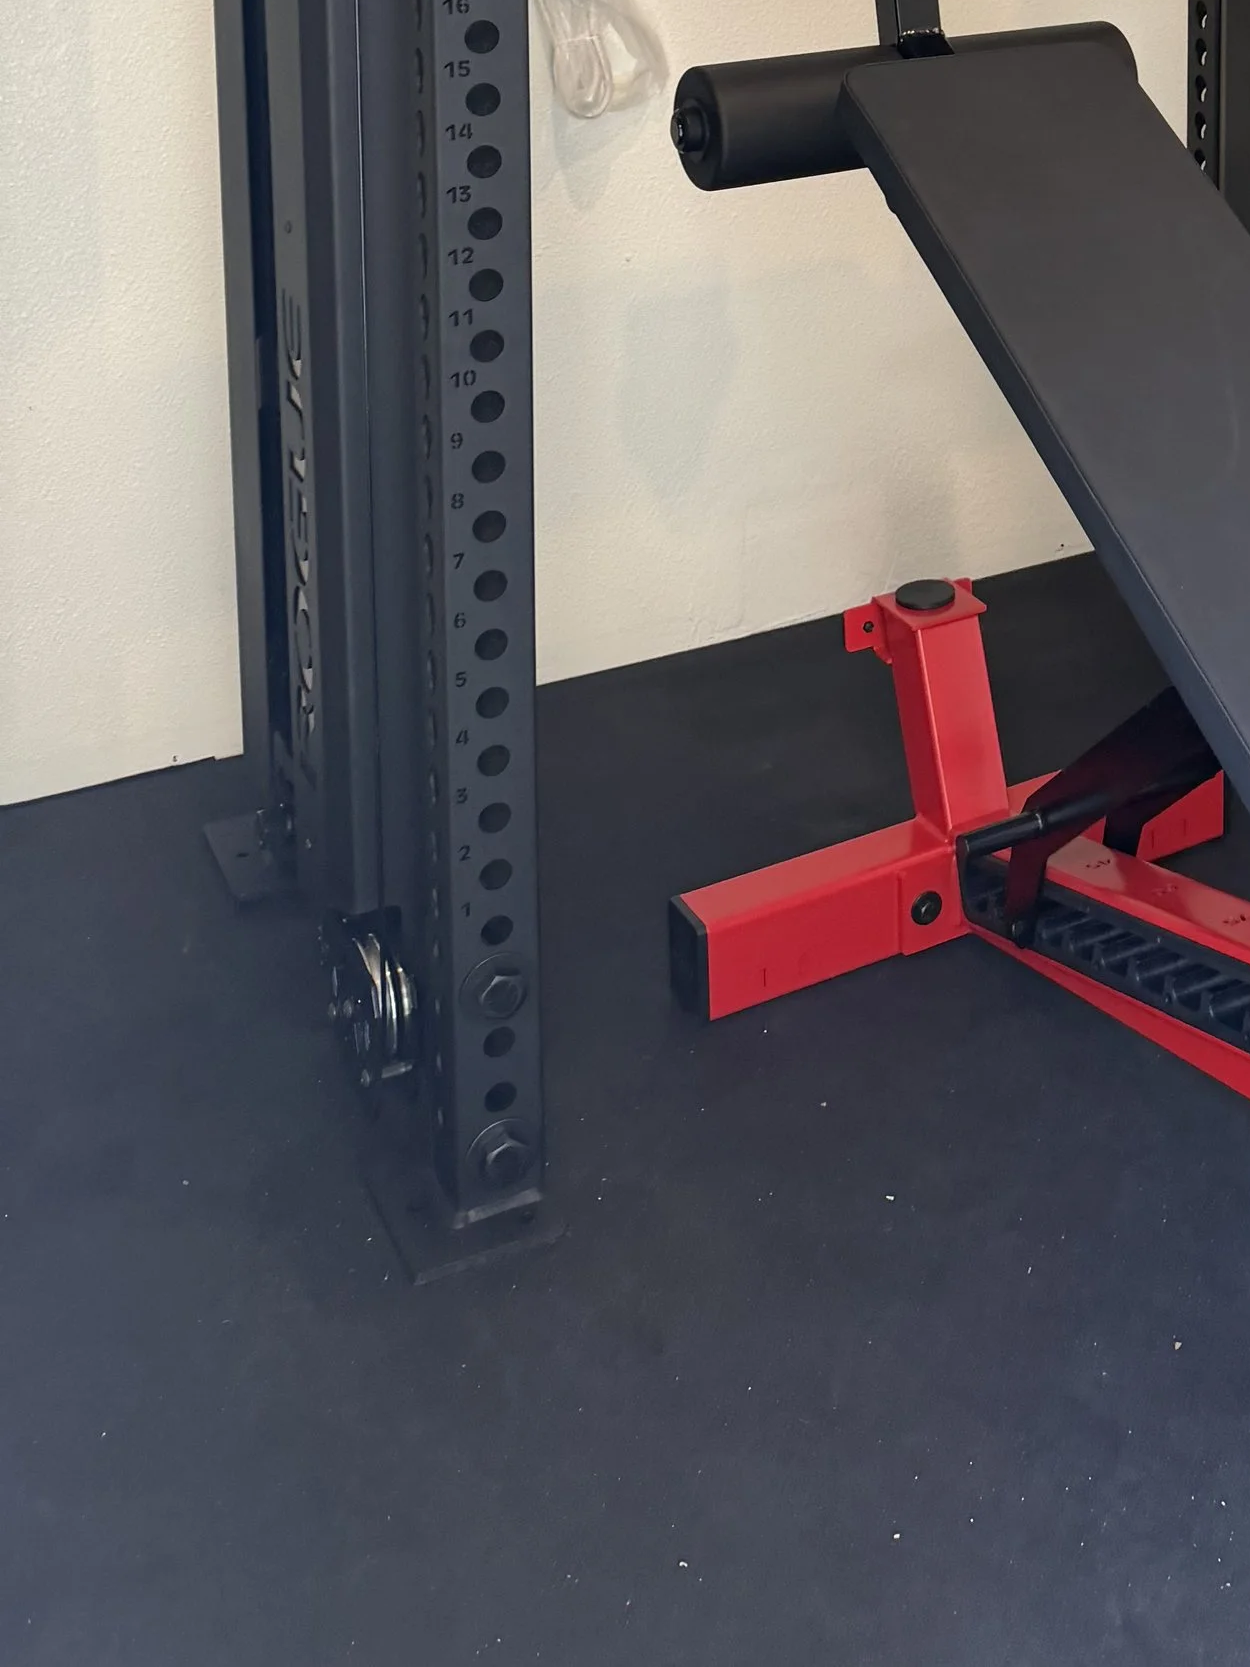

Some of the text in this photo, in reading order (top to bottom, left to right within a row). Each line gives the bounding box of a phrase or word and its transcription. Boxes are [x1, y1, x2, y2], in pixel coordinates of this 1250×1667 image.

[444, 60, 471, 77] 15
[445, 123, 473, 140] 14
[446, 185, 471, 203] 13
[448, 247, 474, 265] 12
[449, 309, 473, 326] 11
[450, 370, 476, 387] 10
[451, 433, 463, 449] 9
[451, 493, 464, 509] 8
[453, 553, 465, 569] 7
[454, 613, 466, 628] 6
[455, 672, 467, 687] 5
[456, 730, 469, 745] 4
[456, 788, 468, 804] 3
[459, 845, 471, 861] 2
[461, 902, 471, 917] 1
